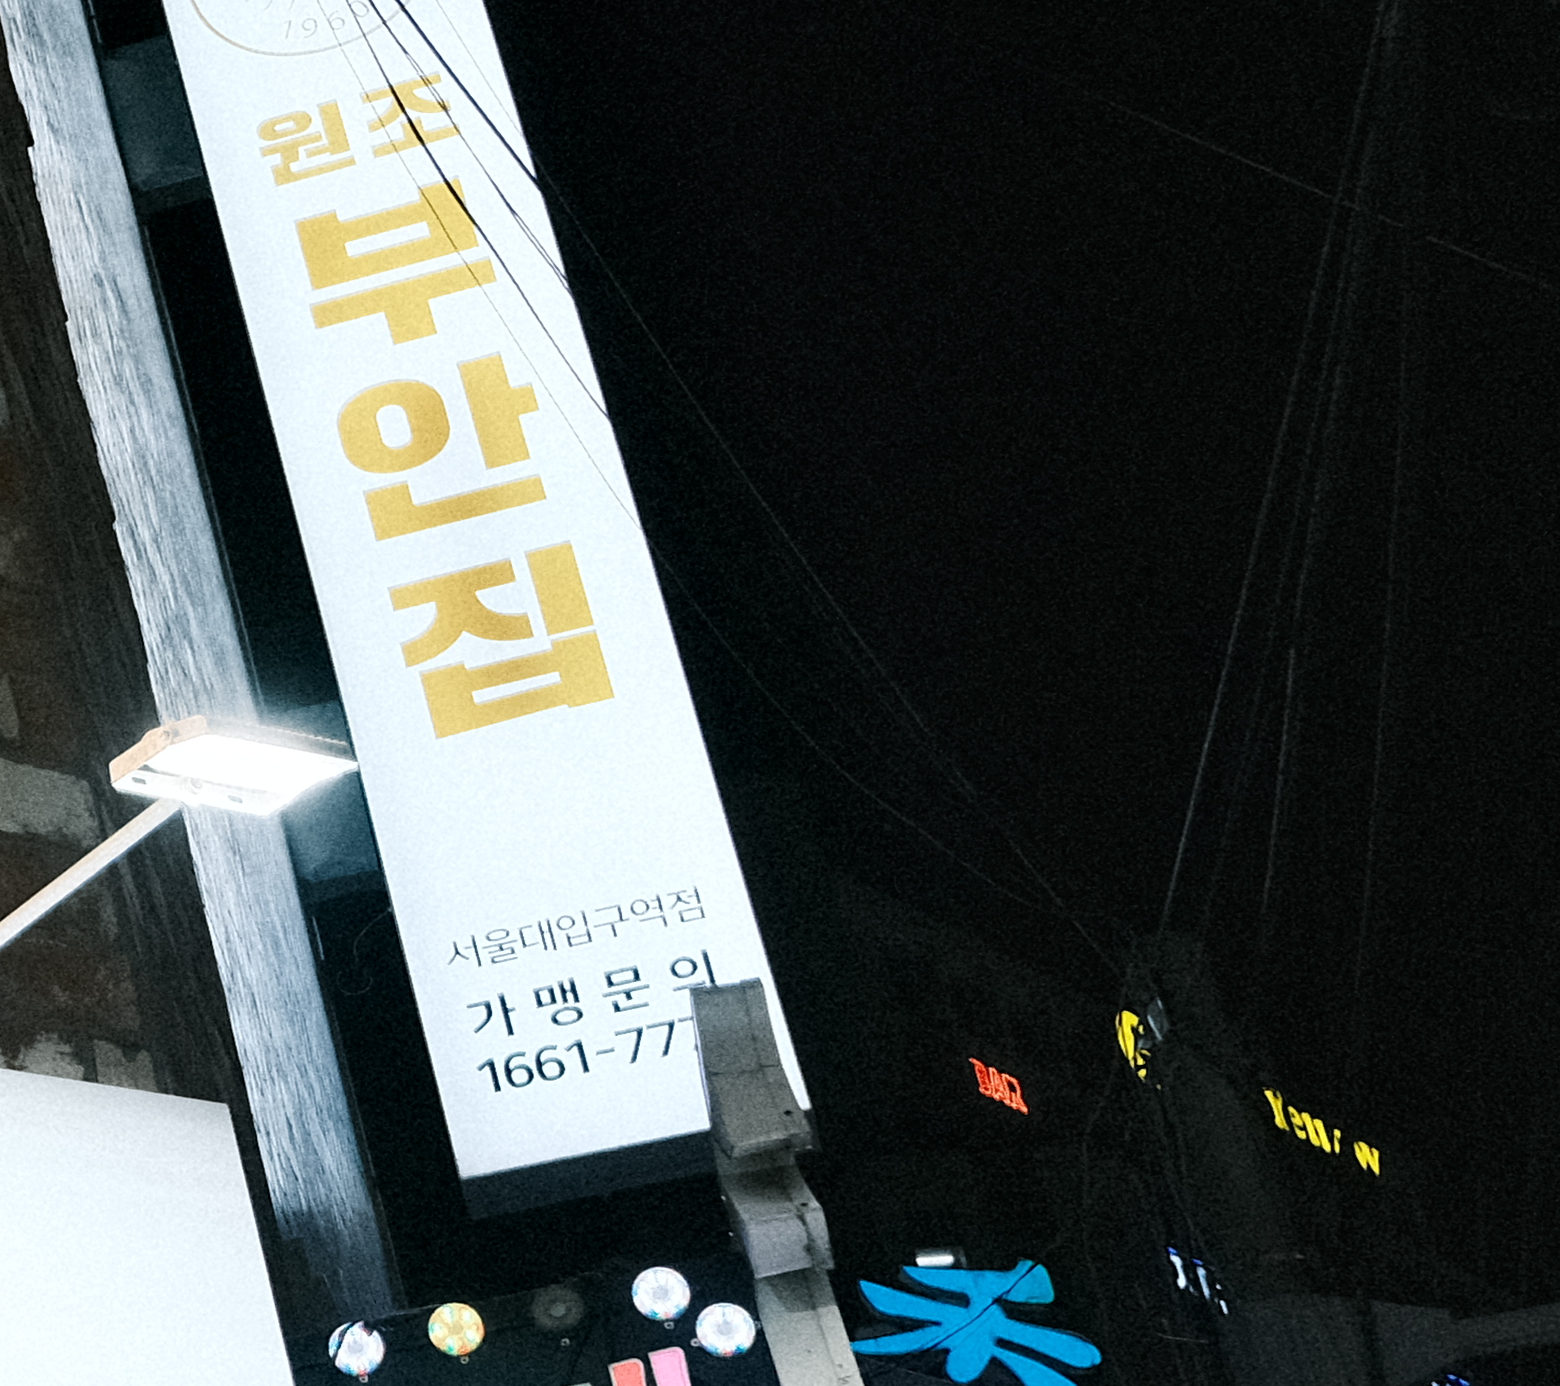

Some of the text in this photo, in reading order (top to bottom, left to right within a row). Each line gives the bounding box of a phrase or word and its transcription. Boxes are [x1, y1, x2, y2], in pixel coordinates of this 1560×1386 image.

[256, 71, 460, 187] 원조
[292, 176, 616, 741] 부안집
[446, 885, 706, 967] 서울대입구역점
[476, 1016, 696, 1093] 1661-77
